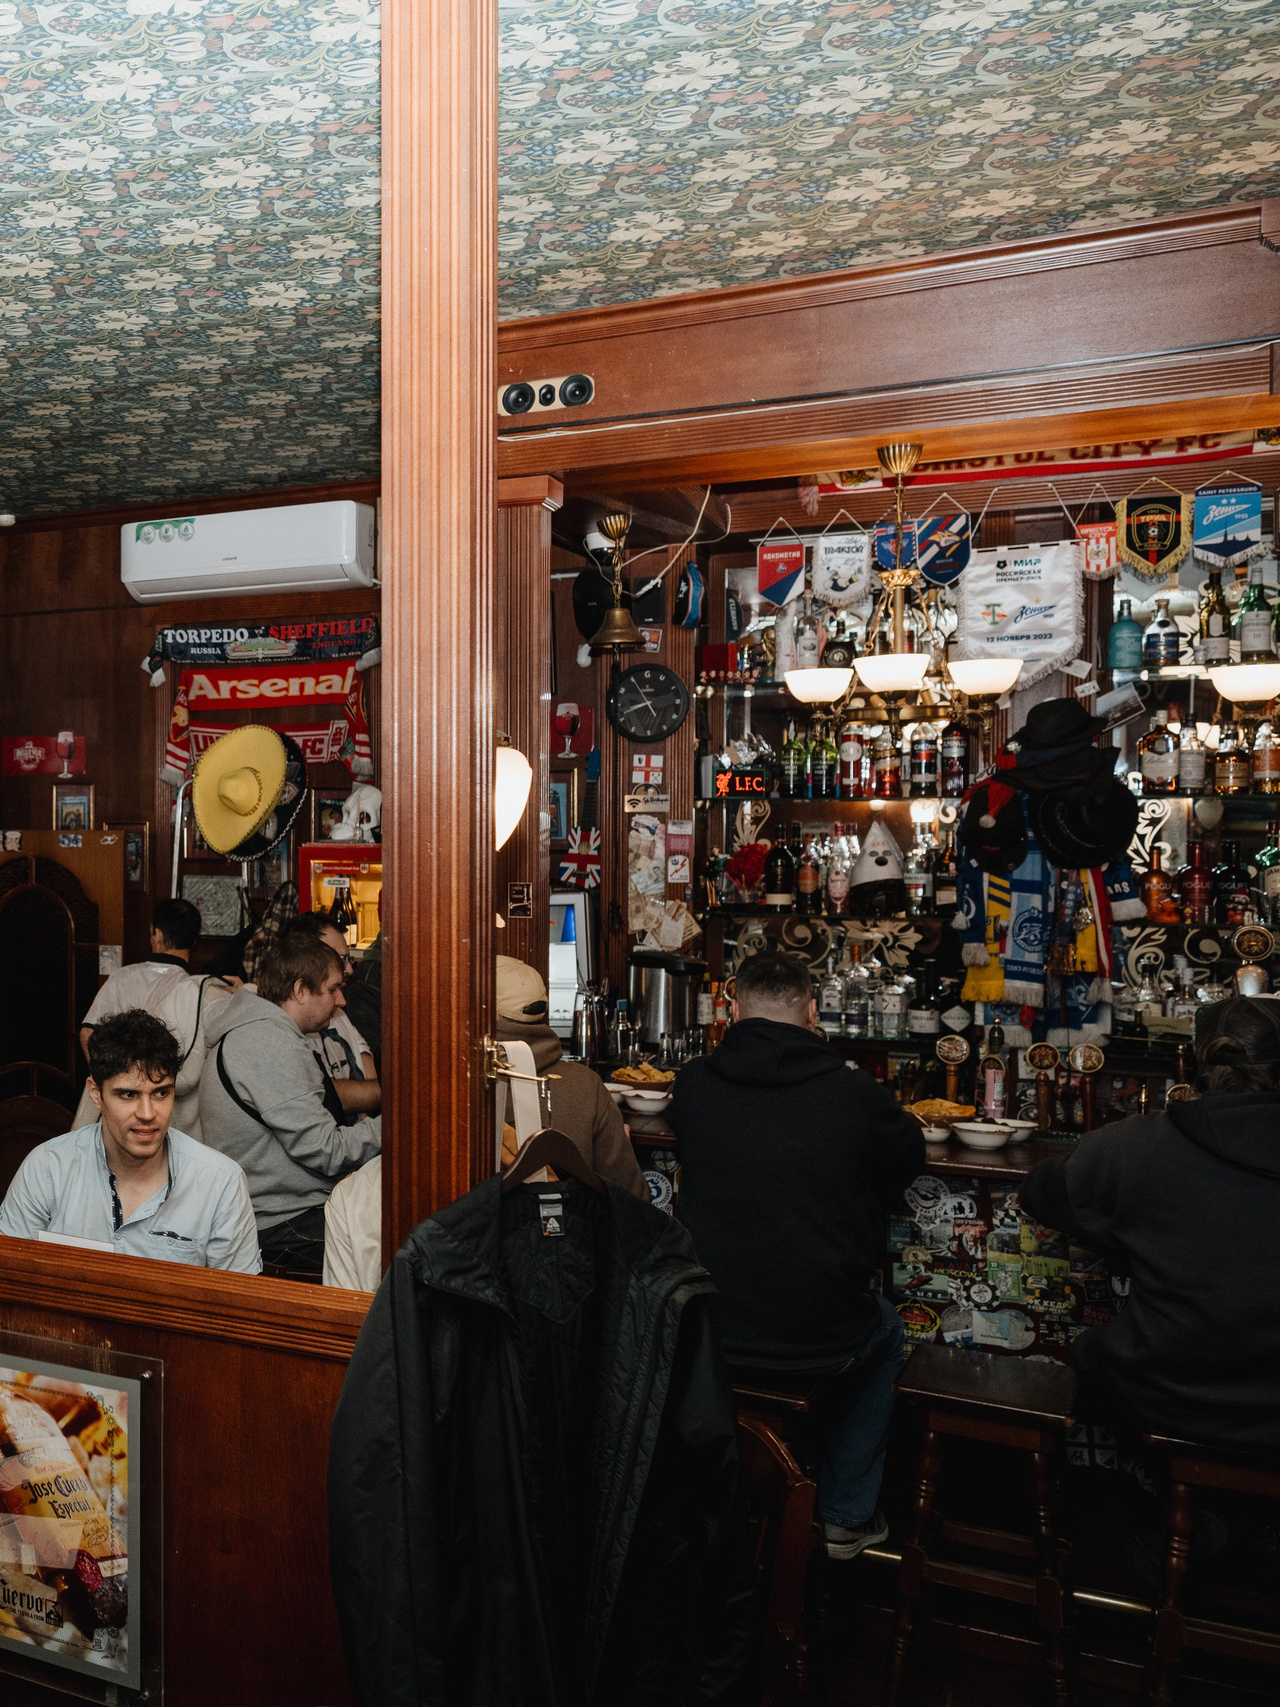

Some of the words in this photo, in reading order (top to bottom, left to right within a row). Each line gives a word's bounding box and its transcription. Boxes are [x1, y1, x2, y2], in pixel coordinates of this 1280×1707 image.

[1218, 485, 1258, 494] PETERSBURG
[763, 550, 801, 559] ЛОКОМОТИВ
[824, 545, 864, 554] TRAKTOR
[1014, 559, 1042, 567] МИР
[996, 569, 1042, 577] РОССИЙСКАЯ
[163, 628, 249, 643] TORPEDO
[268, 617, 374, 639] SHEFFIELD
[996, 634, 1031, 642] НОЯБРЯ
[1033, 632, 1053, 640] 2022
[312, 639, 356, 649] ENGLAND
[188, 666, 356, 701] Arsenal
[302, 738, 325, 755] FC
[735, 777, 765, 791] L.F.C.
[18, 1609, 34, 1619] TEQUILA
[34, 1614, 44, 1622] FROM
